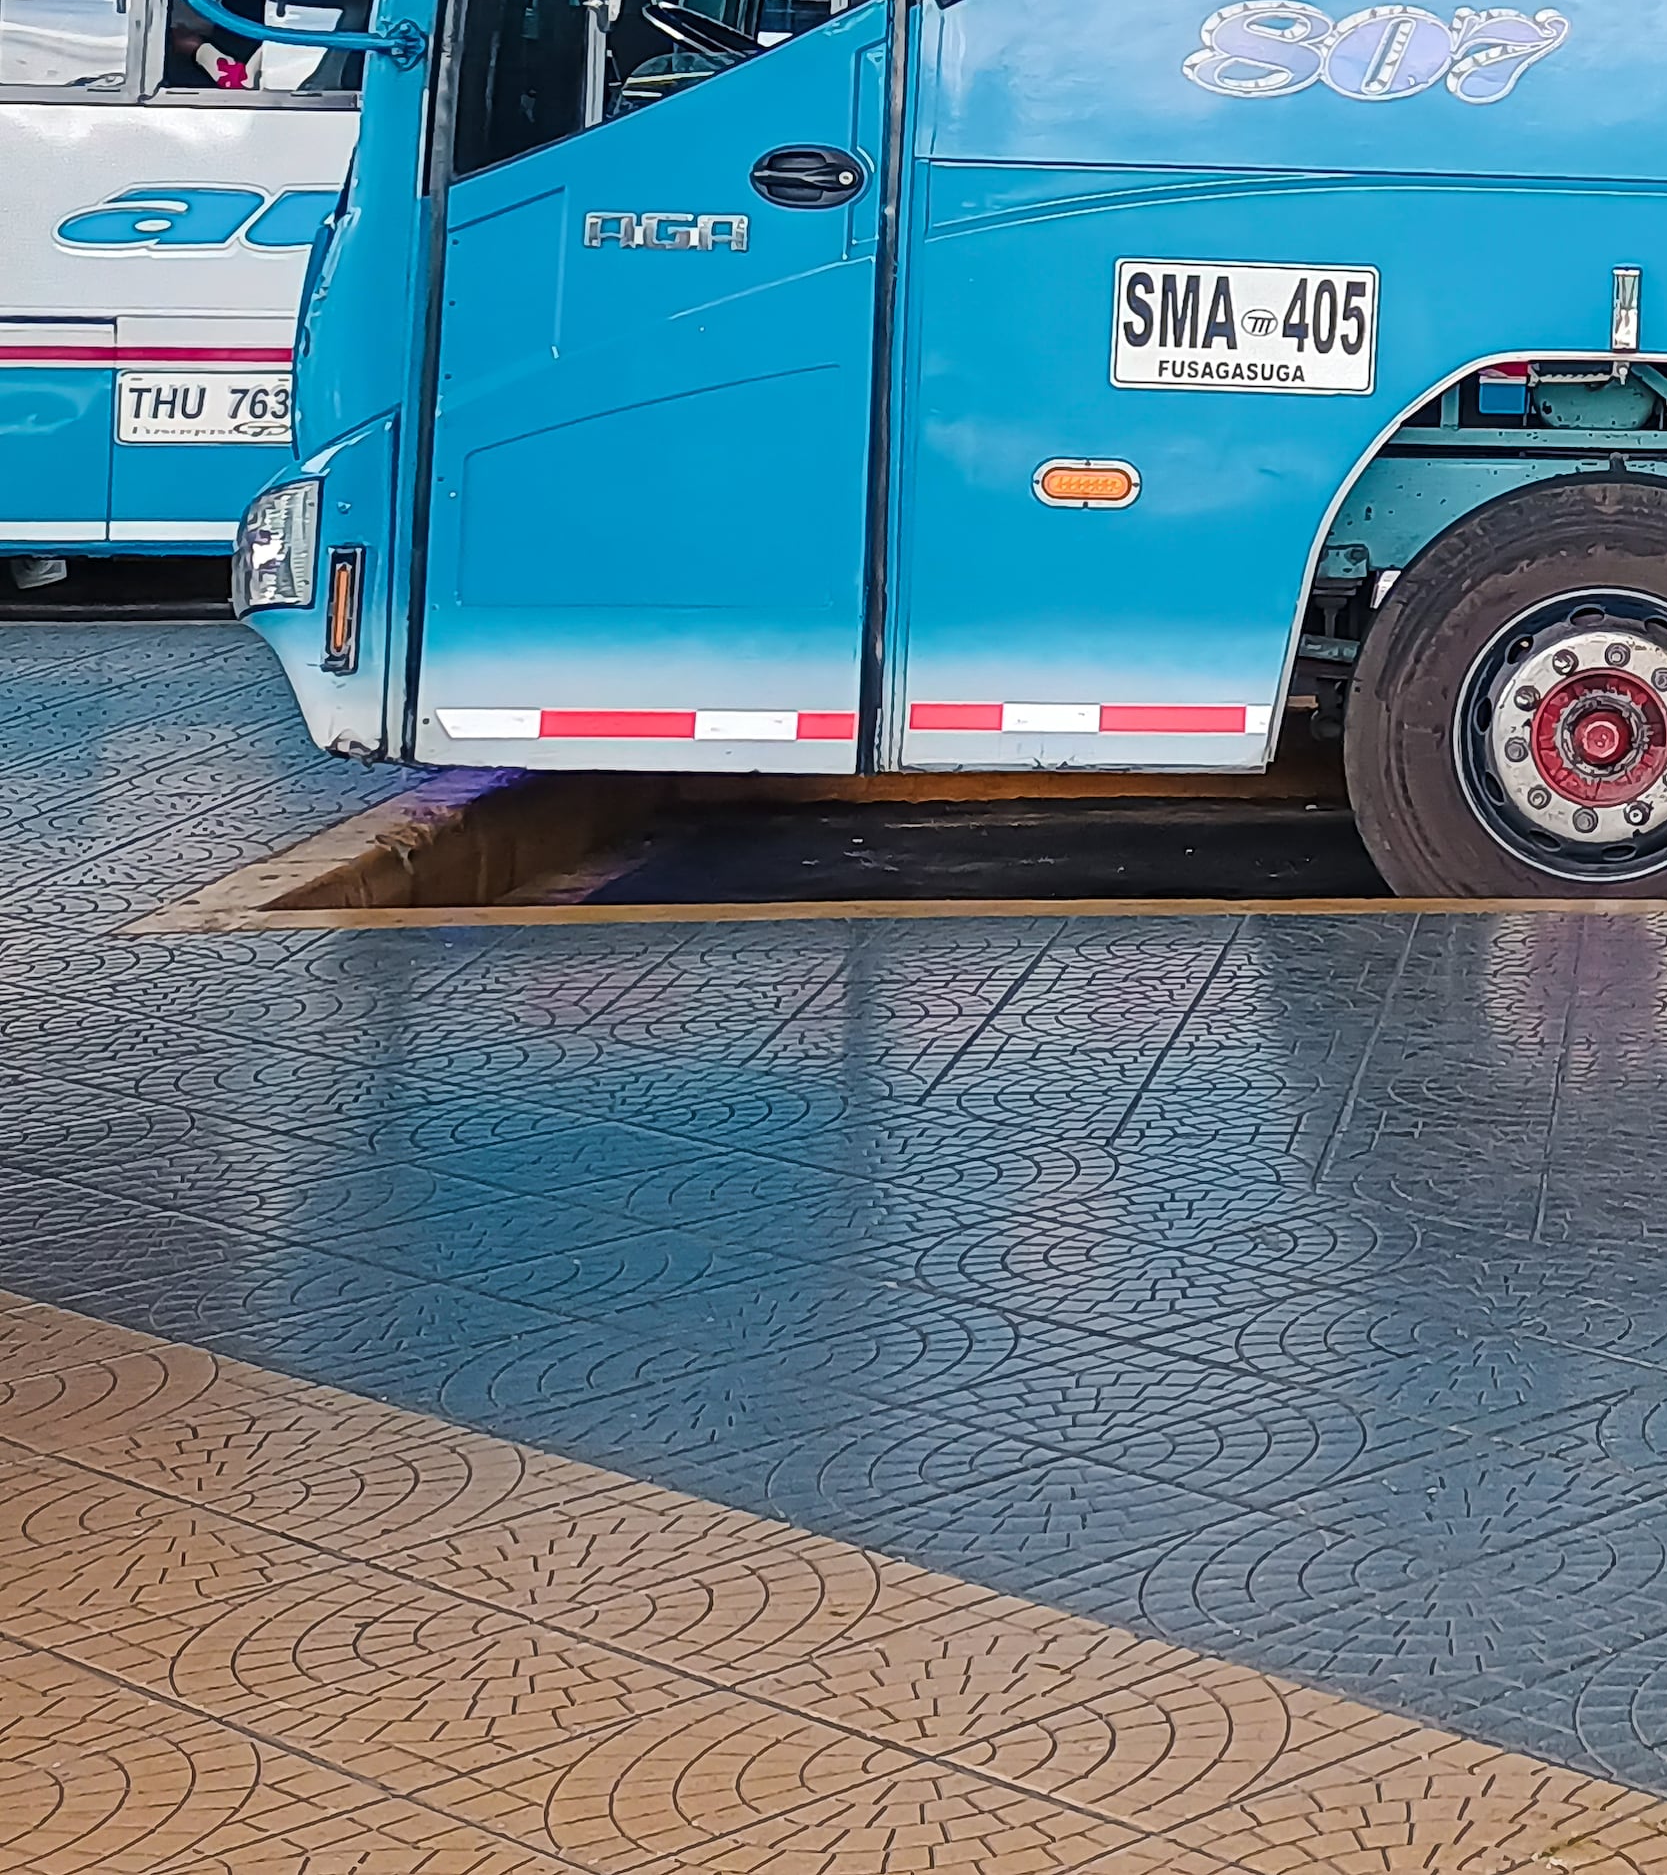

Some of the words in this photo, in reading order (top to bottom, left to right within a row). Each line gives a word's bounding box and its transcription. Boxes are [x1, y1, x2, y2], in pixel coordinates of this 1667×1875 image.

[583, 211, 749, 252] AGA
[1122, 271, 1238, 350] SMA
[1281, 277, 1367, 355] 405
[1158, 359, 1306, 382] FUSAGASUGA
[128, 386, 206, 420] THU
[228, 386, 291, 420] 763
